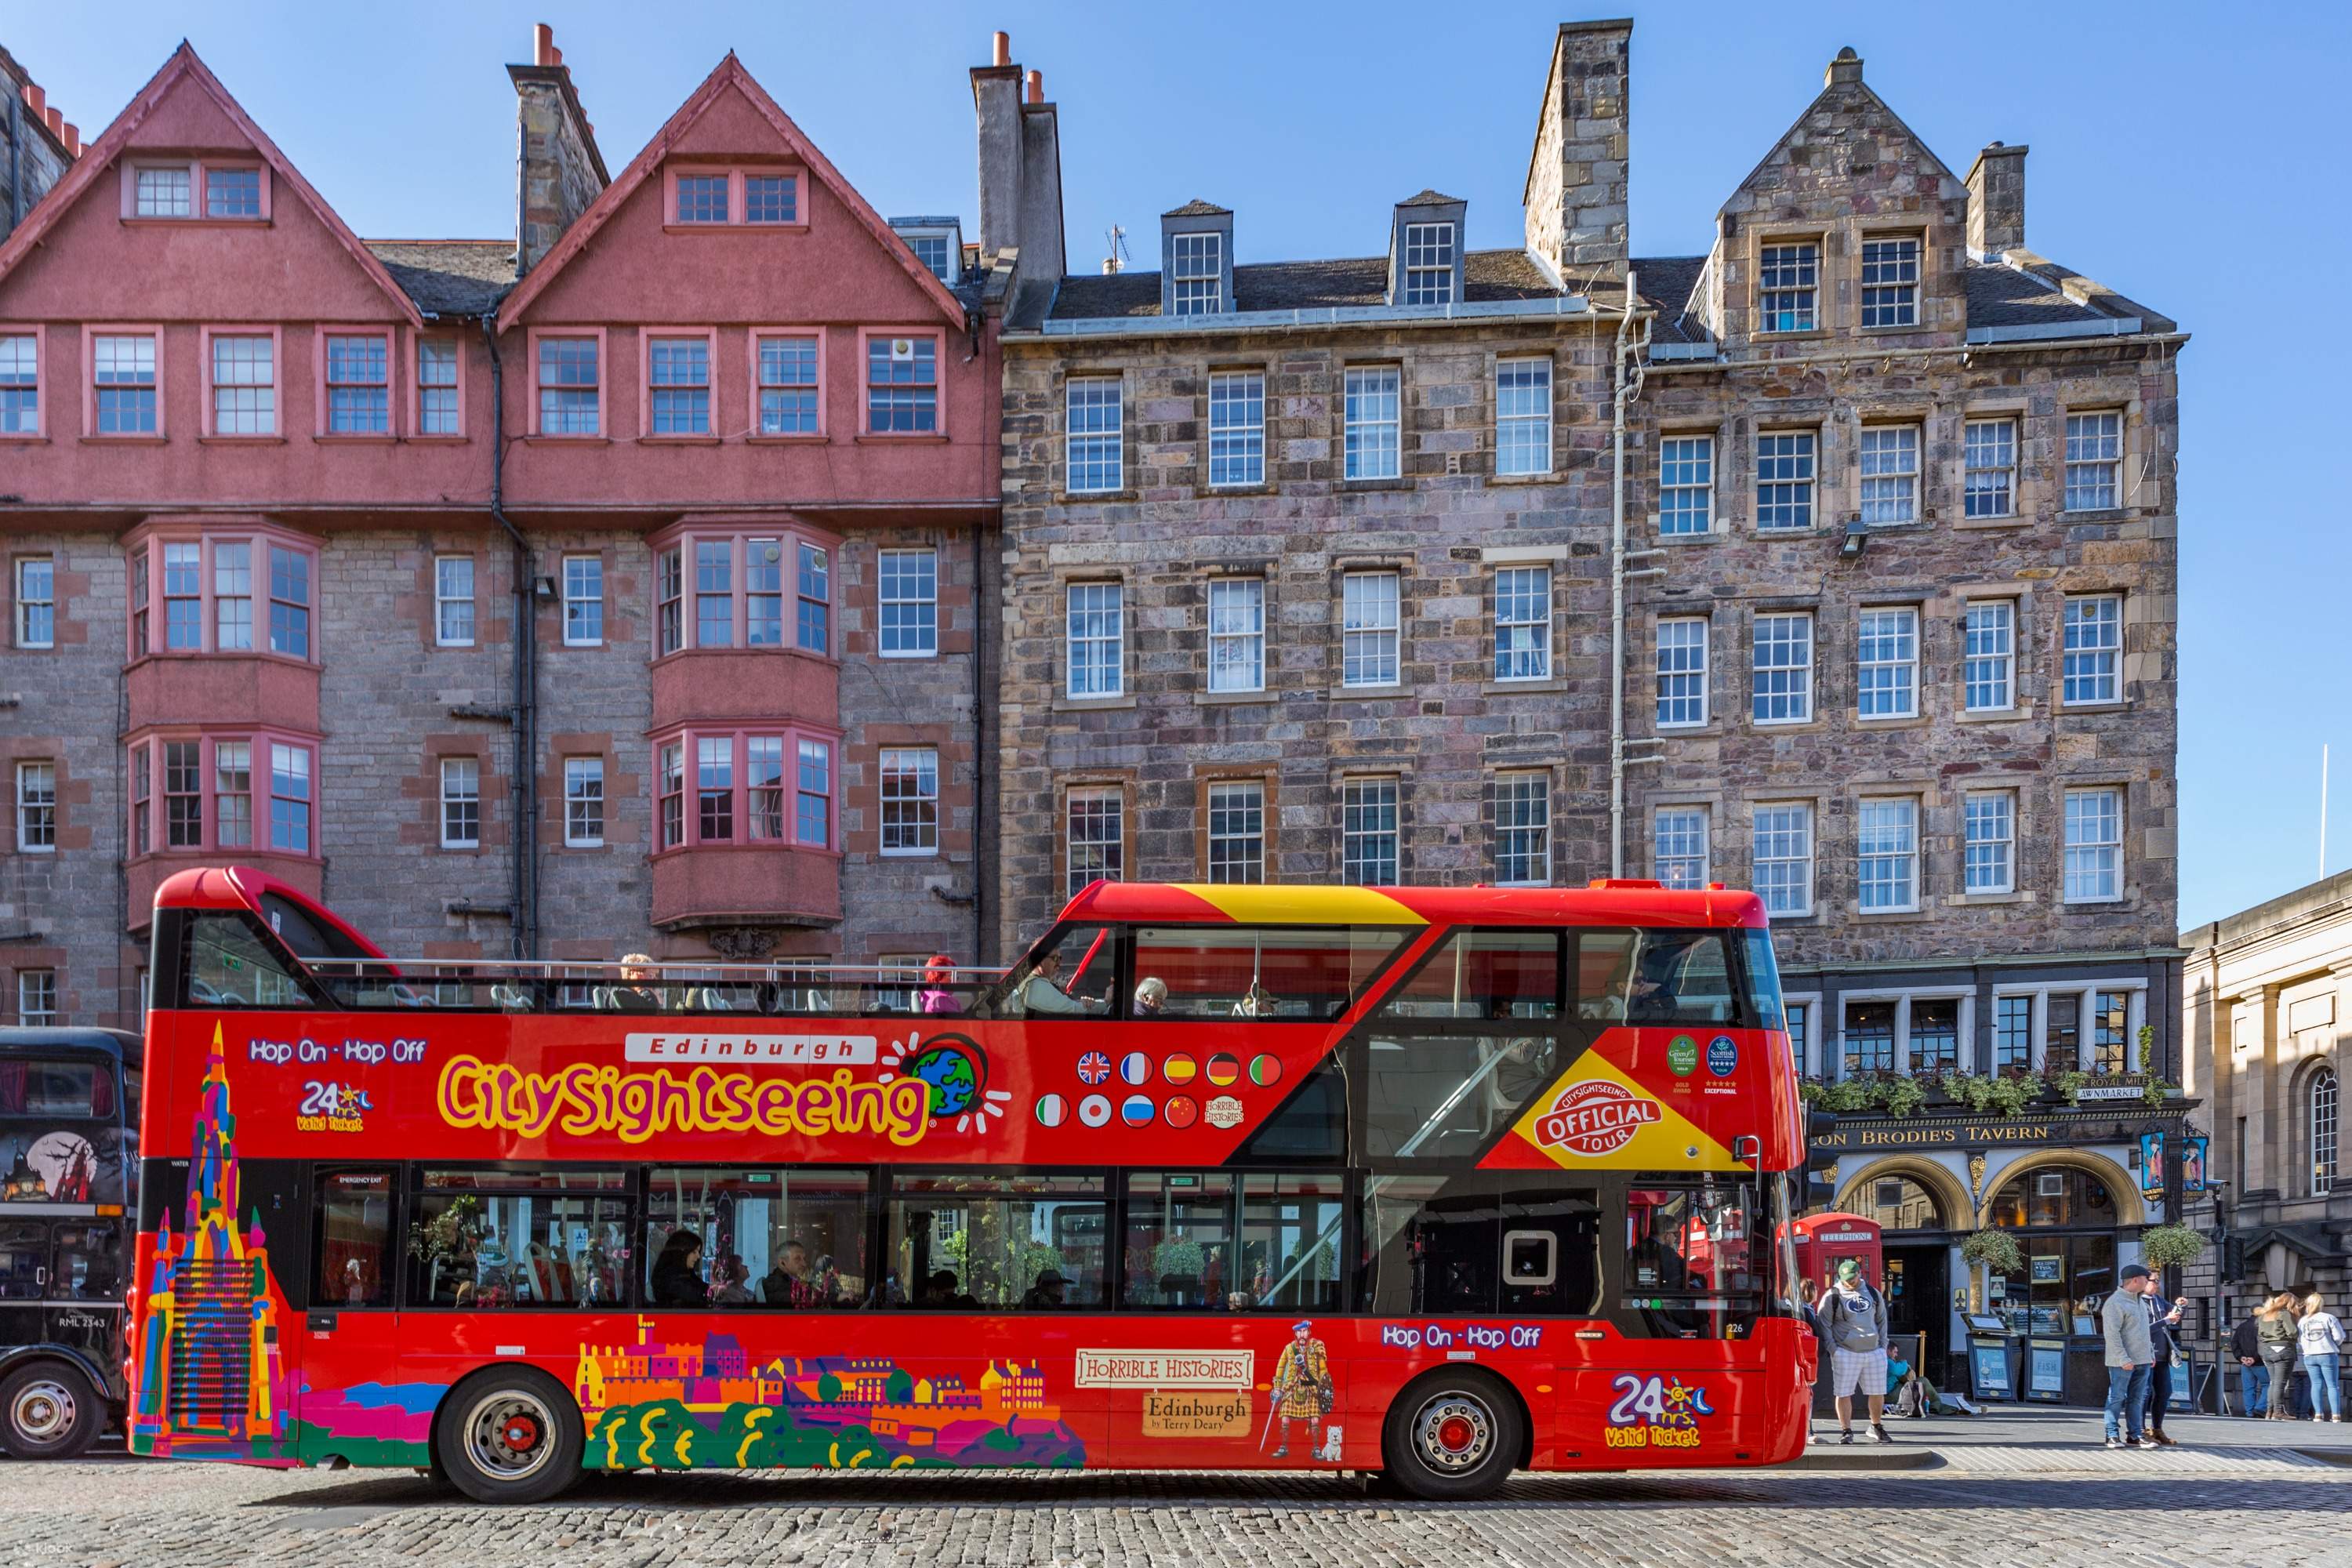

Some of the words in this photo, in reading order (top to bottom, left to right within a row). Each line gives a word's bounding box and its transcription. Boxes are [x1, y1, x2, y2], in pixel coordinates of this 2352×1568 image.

[250, 1040, 292, 1064] Hop
[299, 1039, 327, 1062] On
[345, 1040, 386, 1064] Hop
[393, 1039, 426, 1062] Off
[649, 1038, 853, 1058] Edinburgh
[2090, 1077, 2121, 1087] ROYAL
[2125, 1076, 2147, 1086] MILE
[301, 1080, 339, 1115] 24
[437, 1054, 931, 1145] CitySightseeing
[1207, 1101, 1242, 1111] HORRIBLE
[1562, 1084, 1626, 1108] CITYSIGHTSEEING
[296, 1115, 326, 1131] Valid
[328, 1116, 364, 1131] Ticket
[1206, 1112, 1243, 1122] HISTORIES
[1548, 1102, 1655, 1139] OFFICIAL
[1582, 1129, 1629, 1151] TOUR
[1861, 1130, 1955, 1145] BRODIE'S
[1965, 1127, 2048, 1141] TAVERN
[1823, 1233, 1870, 1242] TELEPHONE
[60, 1318, 80, 1327] RML
[83, 1319, 105, 1328] 2343
[1728, 1323, 1743, 1332] 226
[1383, 1326, 1417, 1348] Hop
[1426, 1326, 1451, 1345] On
[1468, 1326, 1502, 1348] Hop
[1511, 1326, 1542, 1346] Off
[1087, 1359, 1159, 1378] HORRIBLE
[1166, 1359, 1243, 1379] HISTORIES
[1149, 1396, 1246, 1421] Edinburgh
[1610, 1375, 1664, 1423] 24
[1152, 1420, 1160, 1428] by
[1163, 1418, 1189, 1432] Terry
[1194, 1418, 1224, 1431] Deary
[1605, 1426, 1646, 1447] Valid
[1650, 1425, 1700, 1446] Ticket
